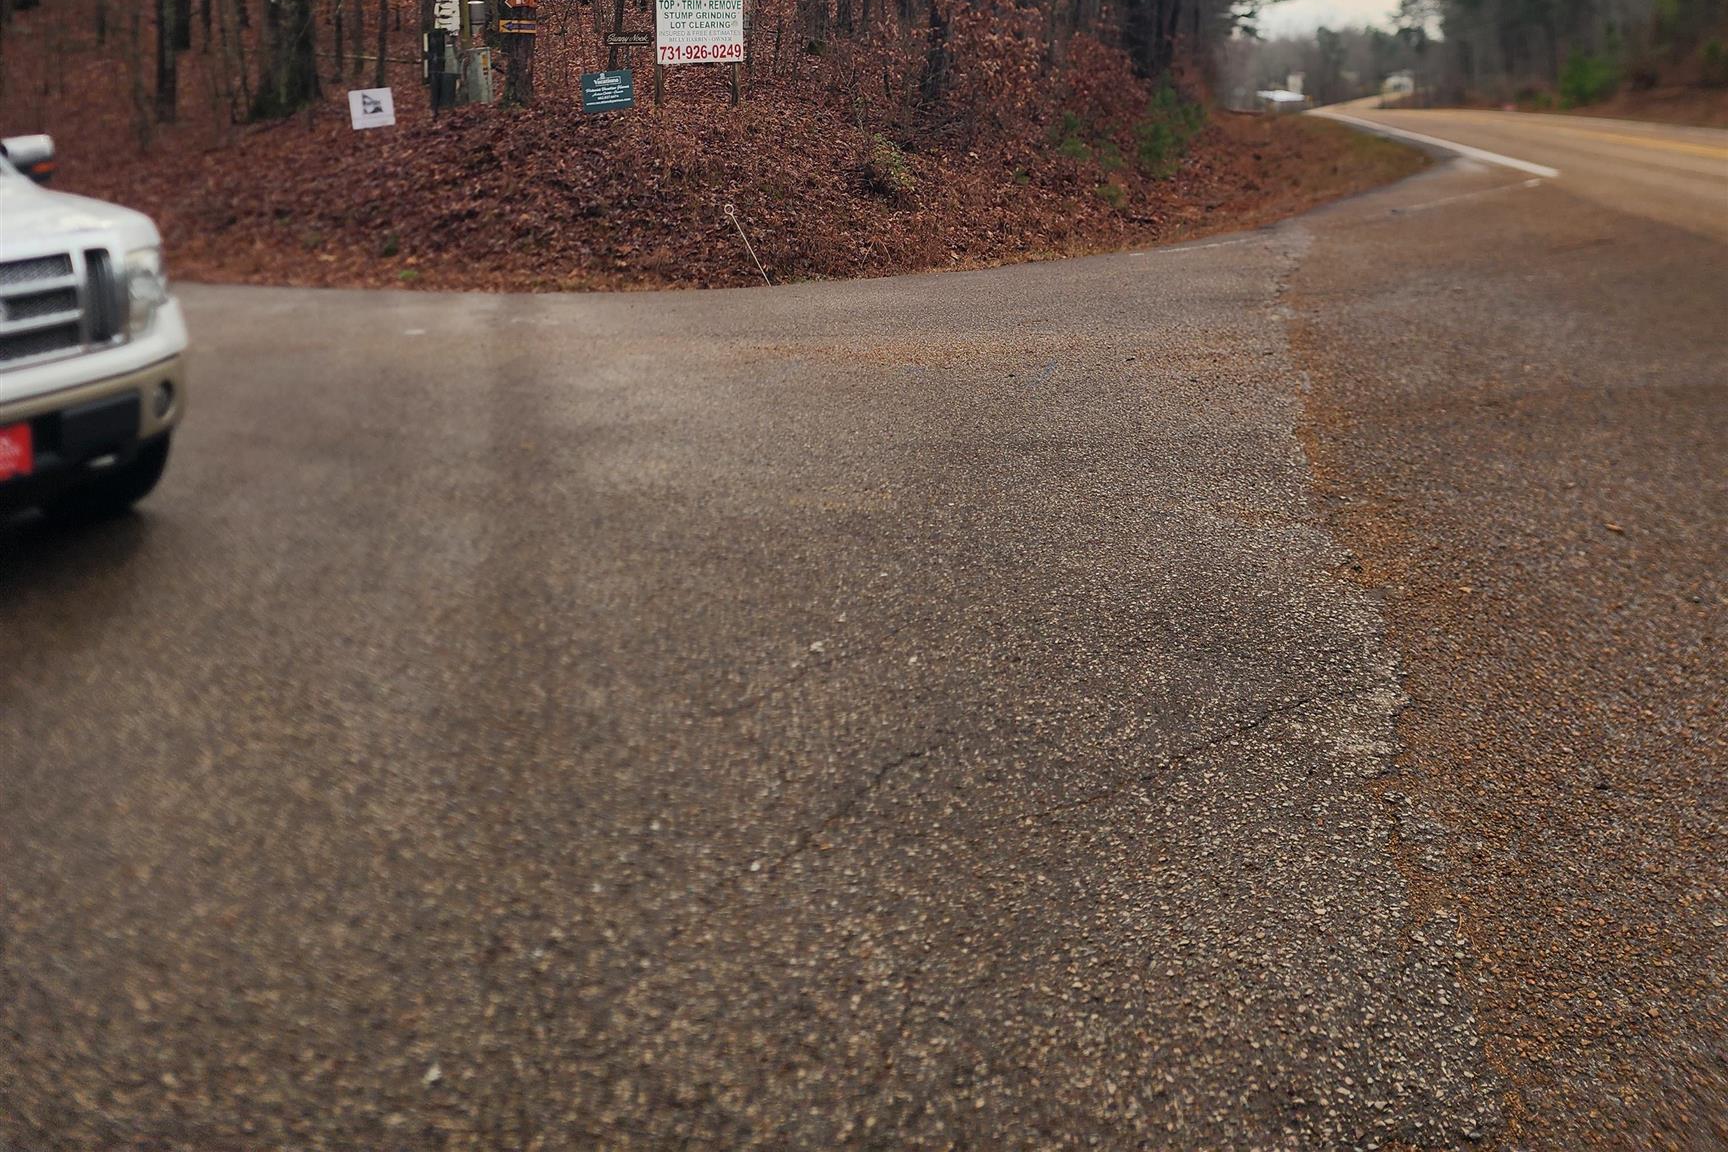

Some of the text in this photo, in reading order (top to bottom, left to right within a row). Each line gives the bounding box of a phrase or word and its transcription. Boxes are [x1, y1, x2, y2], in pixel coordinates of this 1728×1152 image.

[659, 0, 741, 10] TOP TRIM REMOVE
[670, 21, 731, 29] LOT CLEARING
[606, 33, 649, 44] Sunny Nook
[659, 44, 742, 61] 731-926-0249
